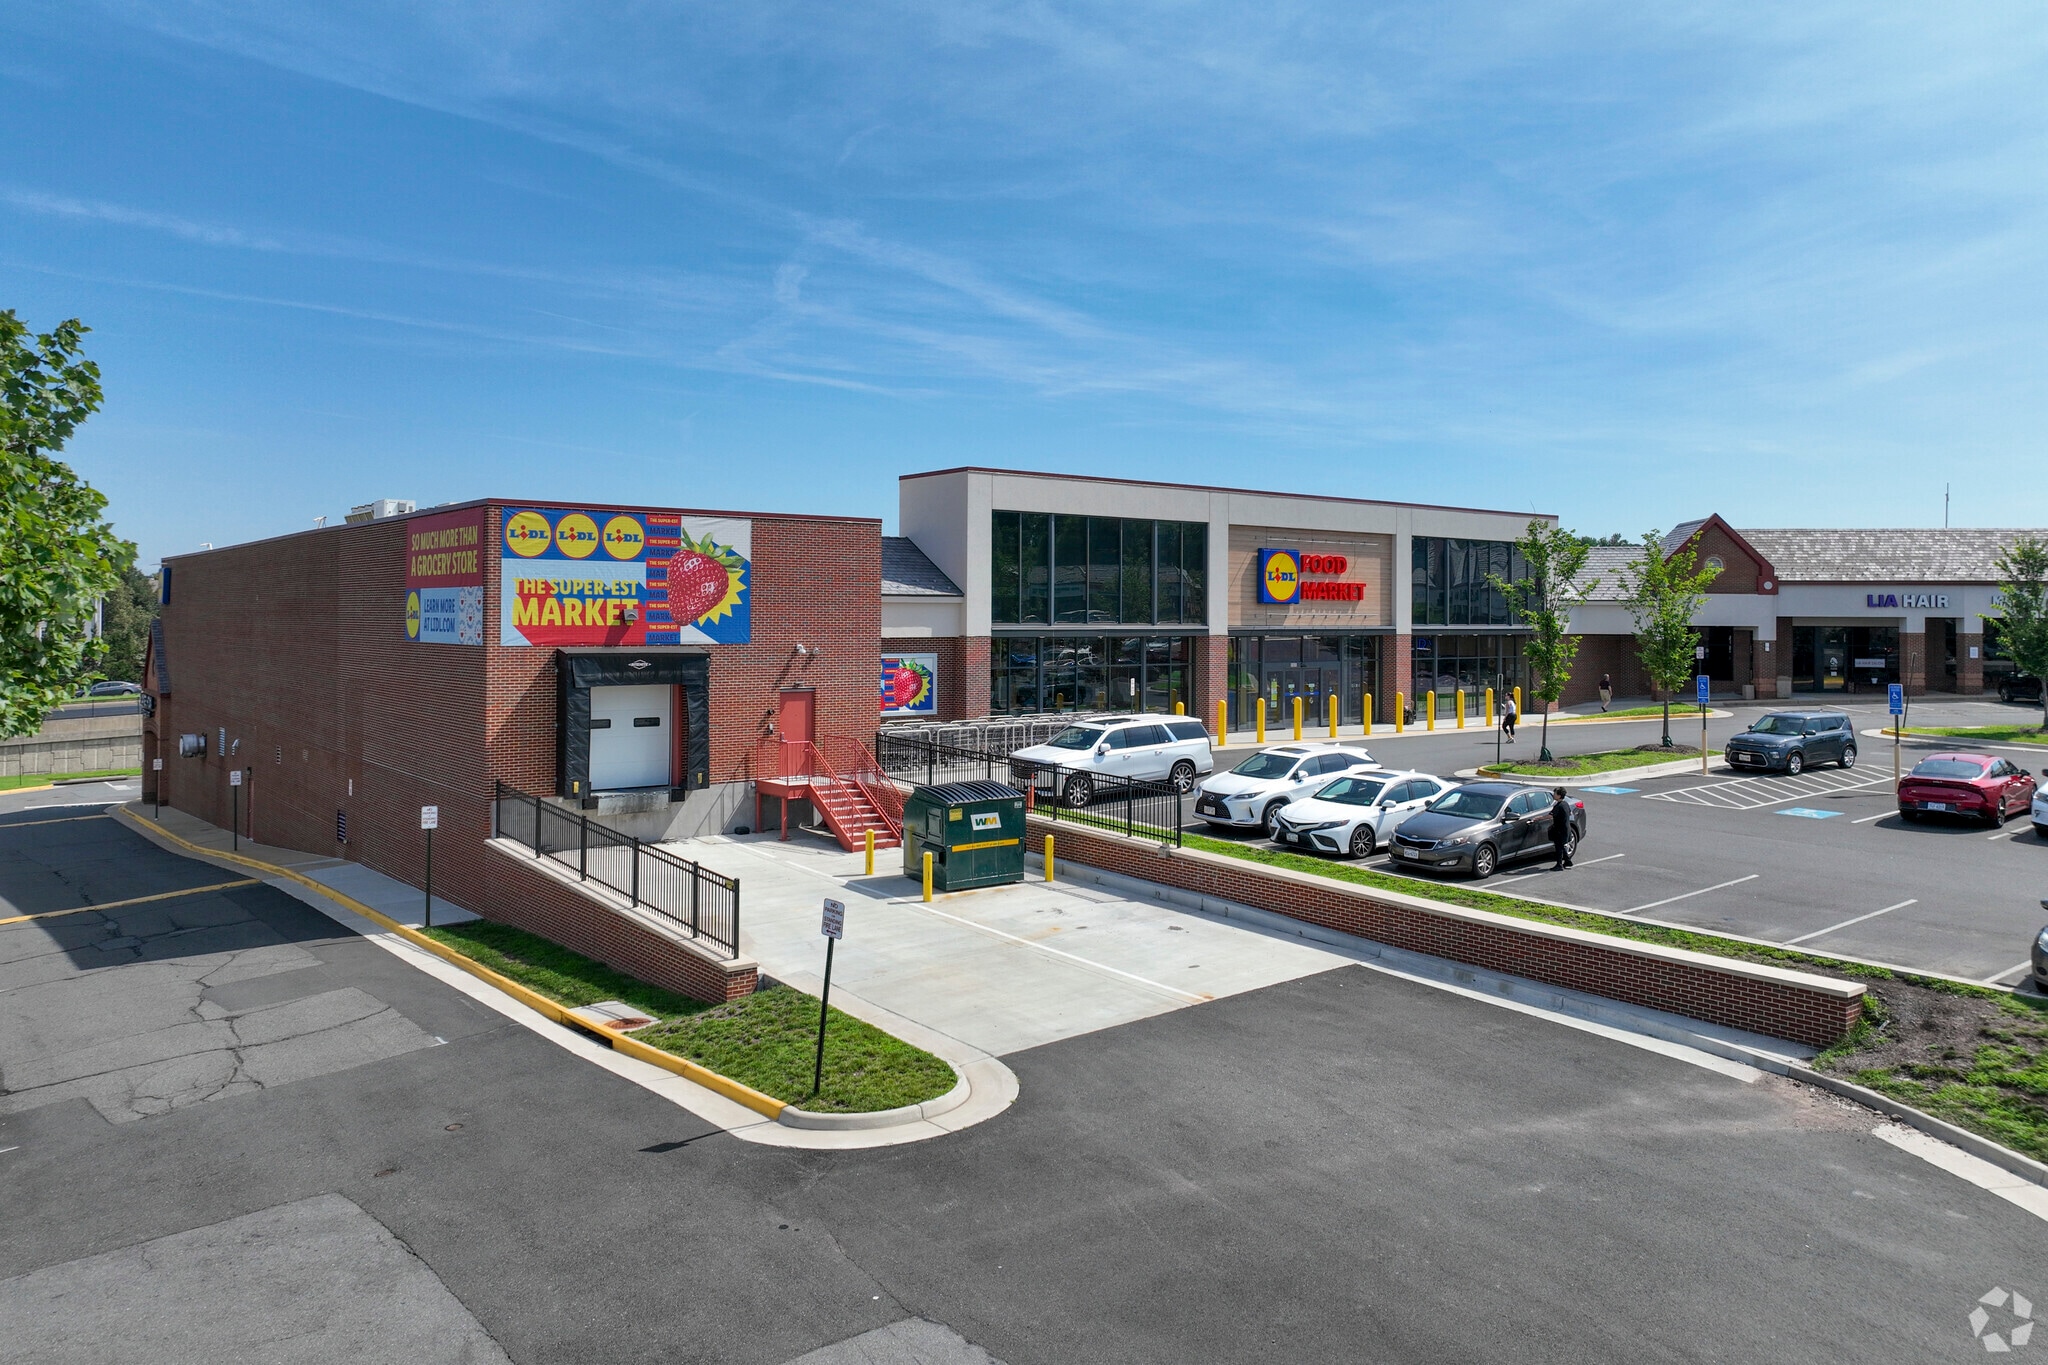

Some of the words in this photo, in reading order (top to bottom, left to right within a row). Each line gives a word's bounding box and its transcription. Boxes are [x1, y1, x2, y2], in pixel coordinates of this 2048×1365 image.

[412, 533, 419, 551] SO
[420, 530, 438, 550] MUCH
[440, 528, 458, 548] MORE
[460, 525, 478, 546] THAN
[650, 528, 678, 536] MARKET
[411, 556, 416, 576] A
[417, 552, 451, 576] GROCERY
[452, 550, 478, 575] STORE
[1300, 554, 1347, 574] FOOD
[512, 578, 546, 594] THE
[550, 578, 640, 596] SUPER-EST
[1301, 582, 1366, 600] MARKET
[424, 599, 439, 613] LEARN
[440, 598, 455, 613] MORE
[1867, 594, 1898, 608] LIA
[1902, 594, 1949, 608] HAIR
[512, 597, 638, 626] MARKET
[424, 618, 430, 631] AT
[430, 618, 455, 632] LIDL.COM
[975, 817, 997, 826] WM
[824, 906, 843, 916] PARKING
